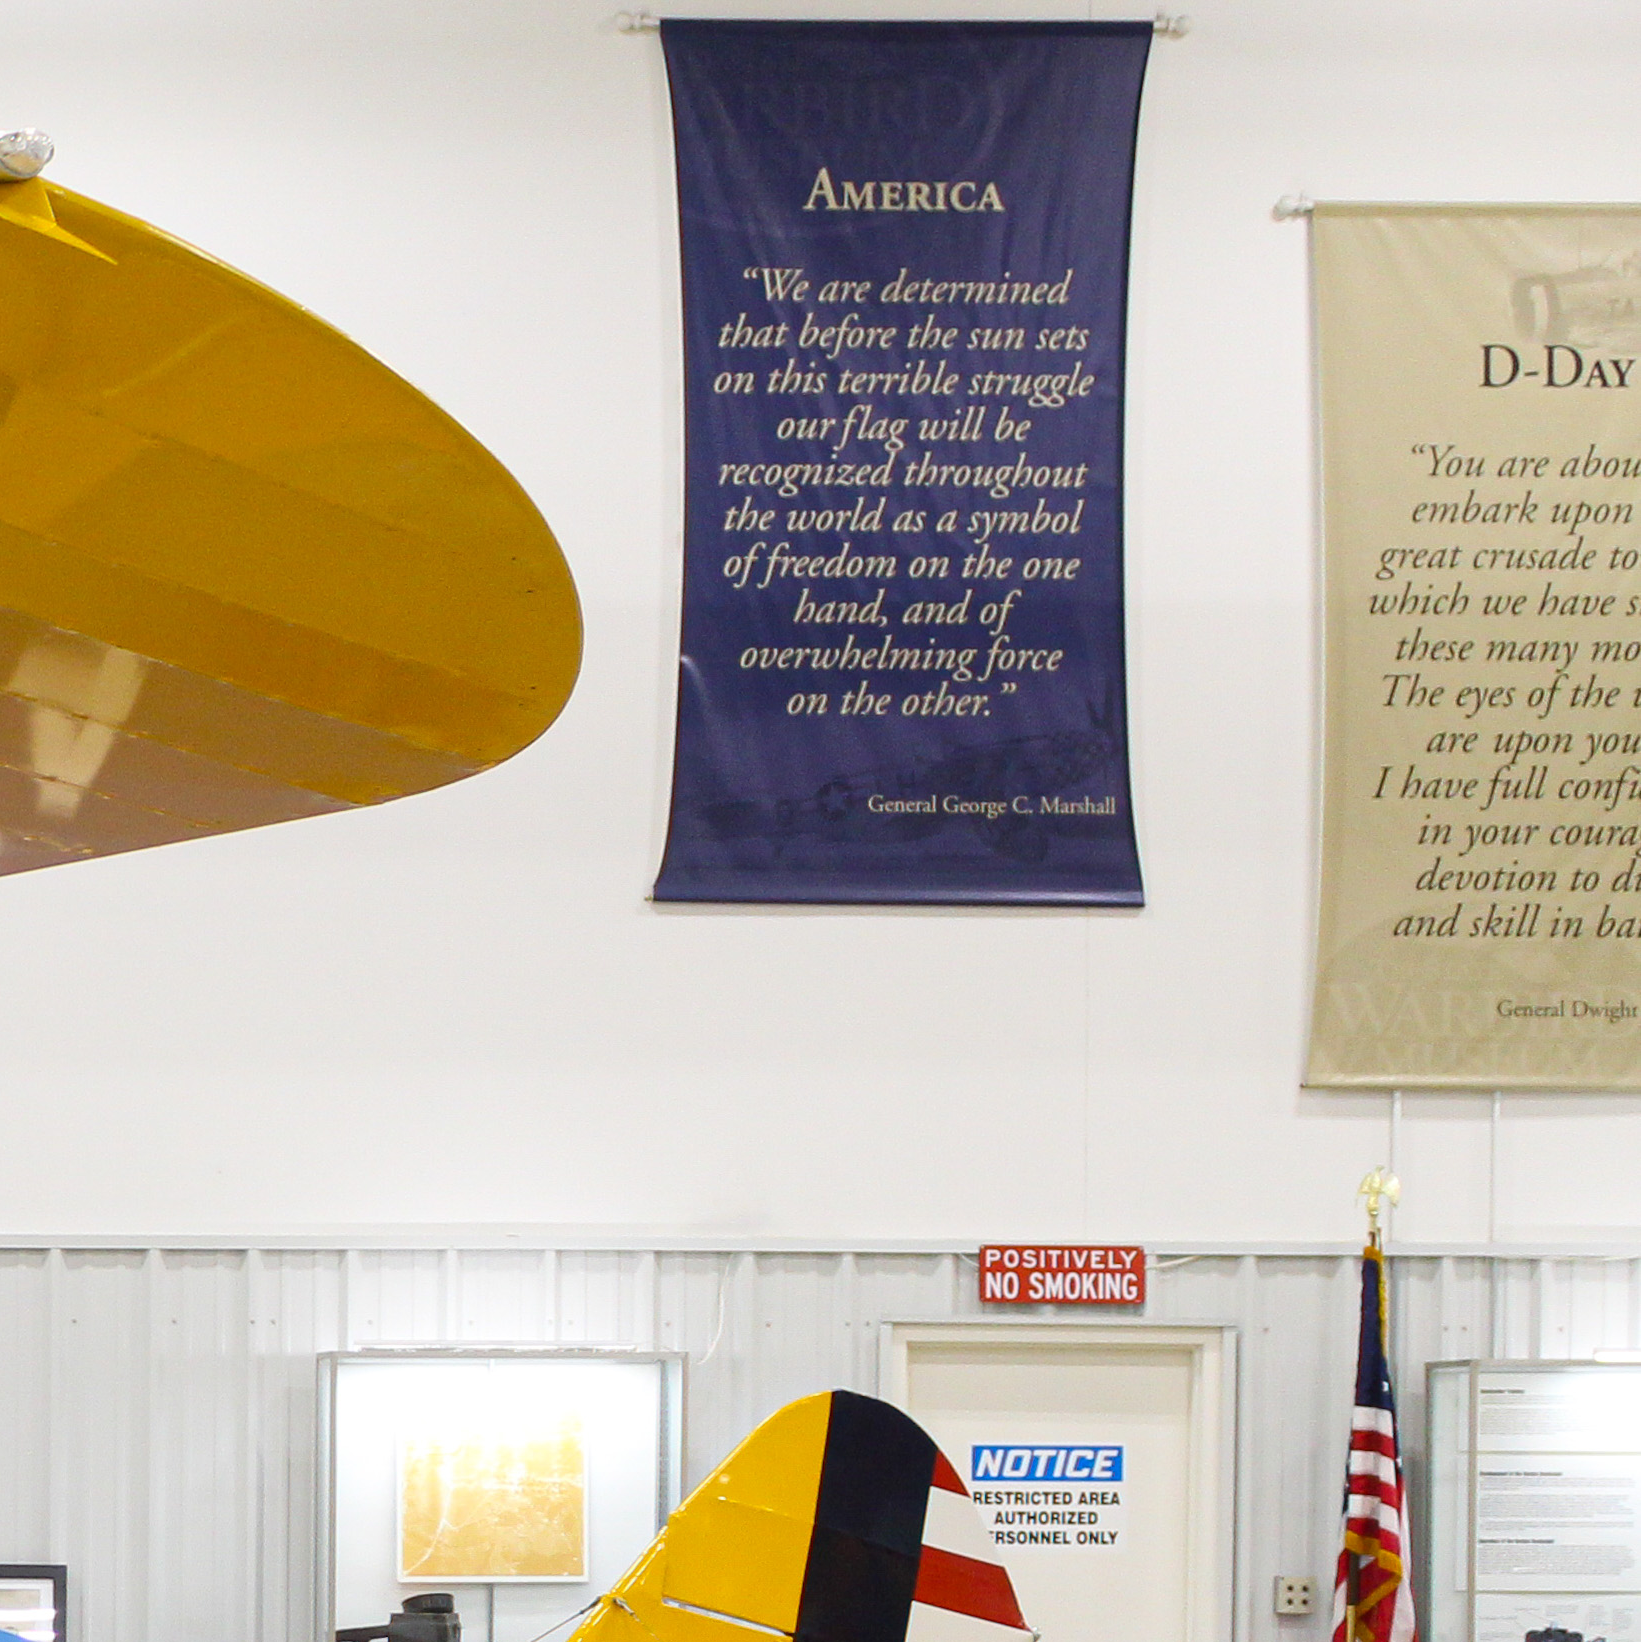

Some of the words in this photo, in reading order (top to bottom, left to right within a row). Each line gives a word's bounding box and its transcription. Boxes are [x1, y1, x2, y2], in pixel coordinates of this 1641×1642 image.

[803, 167, 1004, 211] AMERICA
[744, 268, 809, 301] “We
[818, 281, 871, 302] are
[881, 268, 1072, 304] determined
[719, 313, 788, 347] that
[799, 313, 896, 359] before
[908, 314, 957, 348] the
[967, 328, 1024, 350] sun
[1035, 326, 1089, 350] sets
[714, 372, 754, 393] on
[767, 359, 827, 393] this
[839, 360, 959, 394] terrible
[968, 361, 1094, 407] struggle
[1481, 345, 1634, 387] D-DAY
[777, 418, 836, 439] our
[833, 405, 908, 452] flag
[919, 406, 985, 441] will
[995, 406, 1031, 441] be
[719, 452, 893, 496] recognized
[904, 452, 1088, 498] throughout
[1412, 445, 1484, 477] “You
[1497, 457, 1549, 477] are
[724, 496, 775, 531] the
[787, 497, 885, 531] world
[893, 510, 926, 532] as
[936, 511, 957, 532] a
[967, 499, 1084, 543] symbol
[1412, 489, 1538, 523] embark
[1551, 502, 1632, 535] upon
[724, 542, 766, 588] of
[766, 542, 896, 589] freedom
[909, 557, 948, 577] on
[962, 544, 1012, 578] the
[1023, 558, 1080, 579] one
[1375, 546, 1462, 580] great
[1473, 536, 1596, 570] crusade
[794, 588, 887, 627] hand,
[902, 589, 972, 624] and
[980, 590, 1021, 635] of
[1370, 581, 1469, 615] which
[1483, 596, 1527, 616] we
[1538, 582, 1615, 616] have
[740, 635, 977, 681] overwhelming
[978, 635, 1063, 681] force
[1396, 627, 1474, 661] these
[1487, 641, 1578, 673] many
[787, 694, 827, 714] on
[840, 681, 891, 715] the
[1383, 673, 1444, 707] The
[1456, 687, 1516, 719] eyes
[1528, 674, 1569, 719] of
[1570, 674, 1620, 707] the
[1426, 732, 1478, 753] are
[1494, 731, 1572, 765] upon
[868, 795, 936, 812] General
[943, 796, 1007, 819] George
[1012, 796, 1033, 814] C.
[1040, 796, 1115, 814] Marshall
[1374, 767, 1392, 798] I
[1401, 765, 1478, 799] have
[1480, 763, 1547, 811] full
[1418, 814, 1451, 845] in
[1459, 824, 1540, 856] your
[1416, 857, 1556, 891] devotion
[1570, 869, 1599, 891] to
[1393, 903, 1462, 937] and
[1469, 903, 1540, 937] skill
[1550, 907, 1582, 938] in
[1497, 1000, 1564, 1018] General
[1572, 1000, 1637, 1024] Dwight
[985, 1249, 1137, 1269] POSITIVELY
[987, 1272, 1018, 1298] NO
[1029, 1272, 1136, 1299] SMOKING
[976, 1449, 1119, 1478] NOTICE
[973, 1492, 1072, 1505] RESTRICTED
[1079, 1492, 1119, 1505] AREA
[995, 1512, 1098, 1524] AUTHORIZED
[989, 1531, 1070, 1544] RSONNEL
[1077, 1531, 1117, 1544] ONLY
